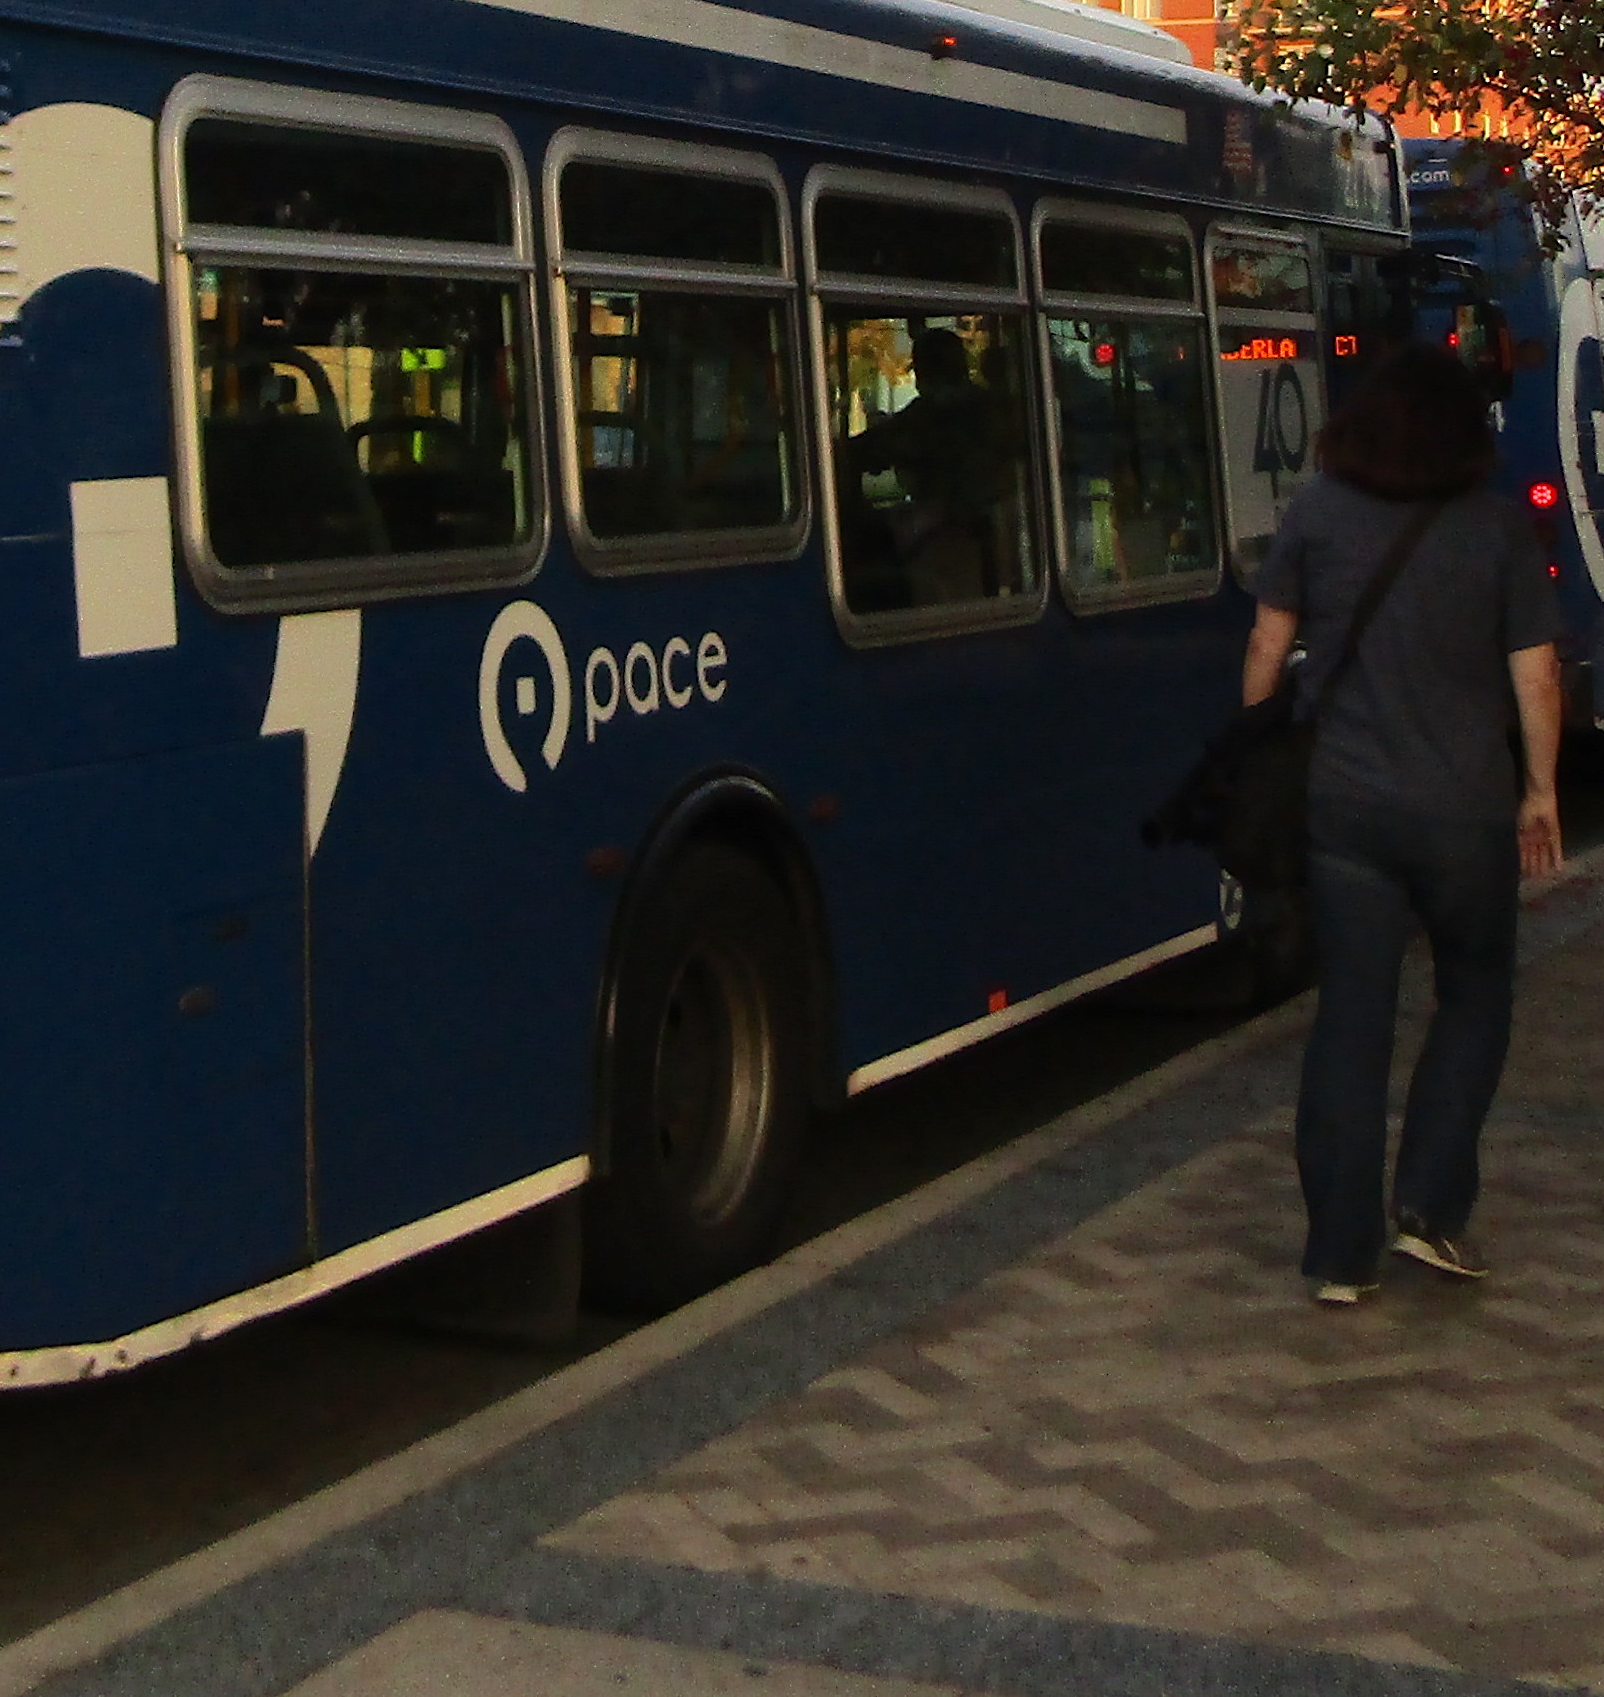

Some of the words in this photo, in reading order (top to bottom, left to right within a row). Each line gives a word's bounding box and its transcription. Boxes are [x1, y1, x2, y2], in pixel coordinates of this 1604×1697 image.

[1404, 169, 1451, 184] .com
[1219, 337, 1298, 360] ERLA
[583, 631, 729, 744] pace
